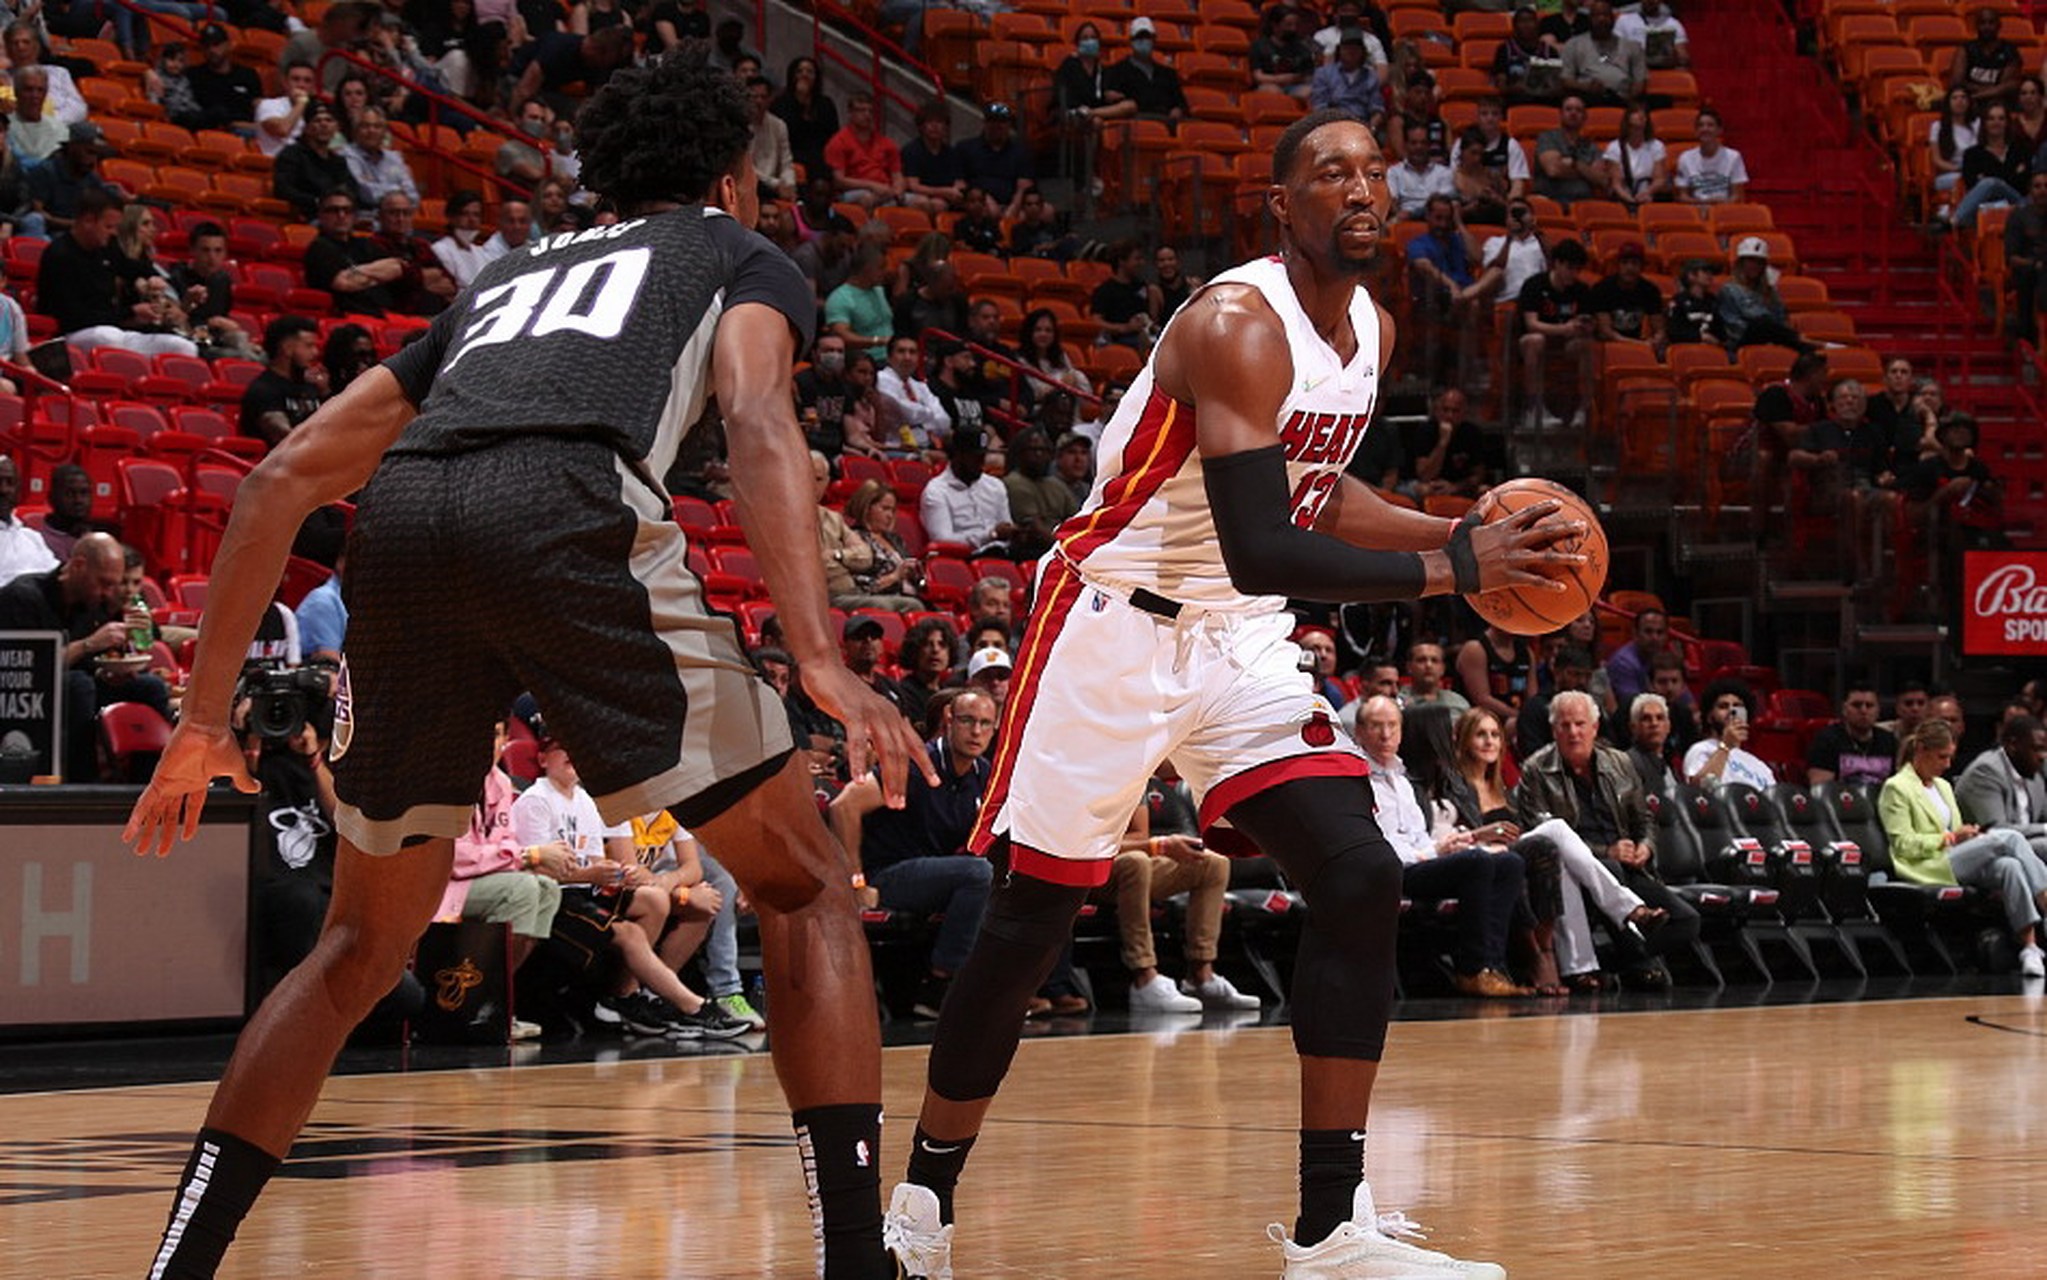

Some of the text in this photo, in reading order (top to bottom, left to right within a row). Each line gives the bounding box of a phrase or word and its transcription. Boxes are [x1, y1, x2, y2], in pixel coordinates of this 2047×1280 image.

[441, 247, 652, 374] 30
[1280, 410, 1368, 464] HEAT
[20, 861, 93, 986] H
